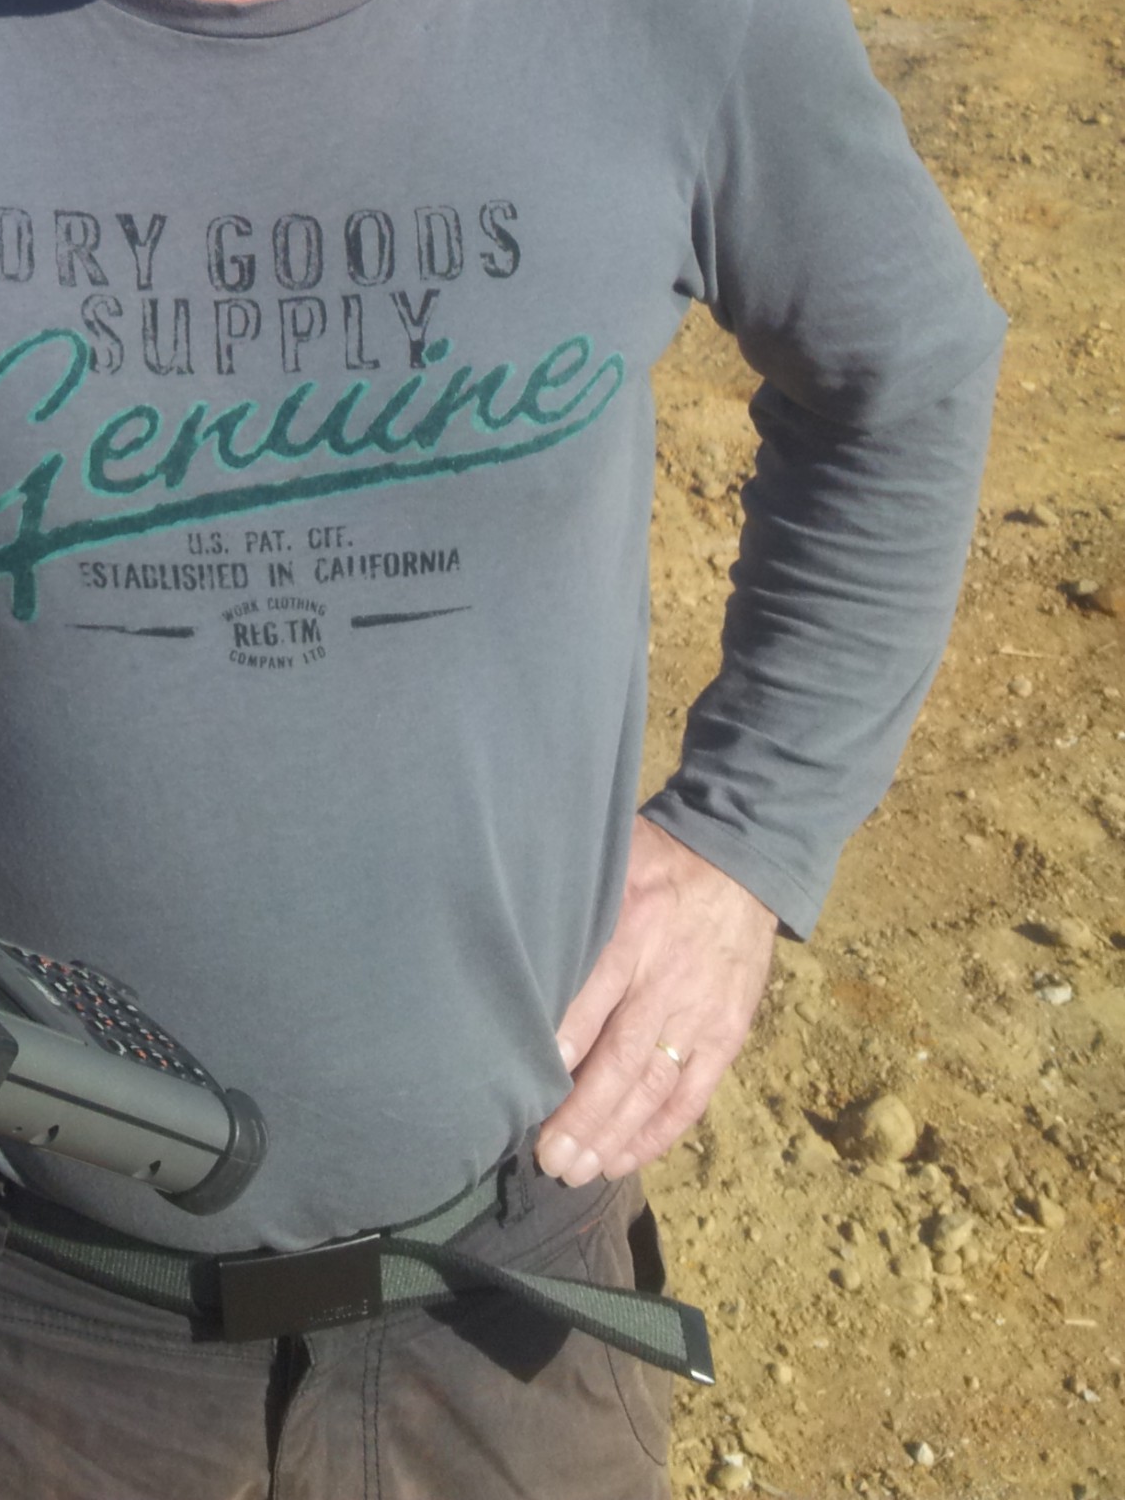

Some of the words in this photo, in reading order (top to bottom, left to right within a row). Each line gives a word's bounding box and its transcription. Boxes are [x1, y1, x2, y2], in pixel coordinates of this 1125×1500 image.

[206, 199, 522, 293] GOODS
[81, 288, 441, 376] SUPPLY
[187, 531, 230, 557] U.S.
[244, 529, 293, 555] PAT.
[79, 561, 249, 590] ESTABLISHED
[268, 560, 295, 588] IN
[314, 548, 461, 584] CALIFORNIA
[221, 599, 260, 622] WORK
[267, 596, 327, 617] CLOTHING
[229, 649, 293, 669] COMPANY
